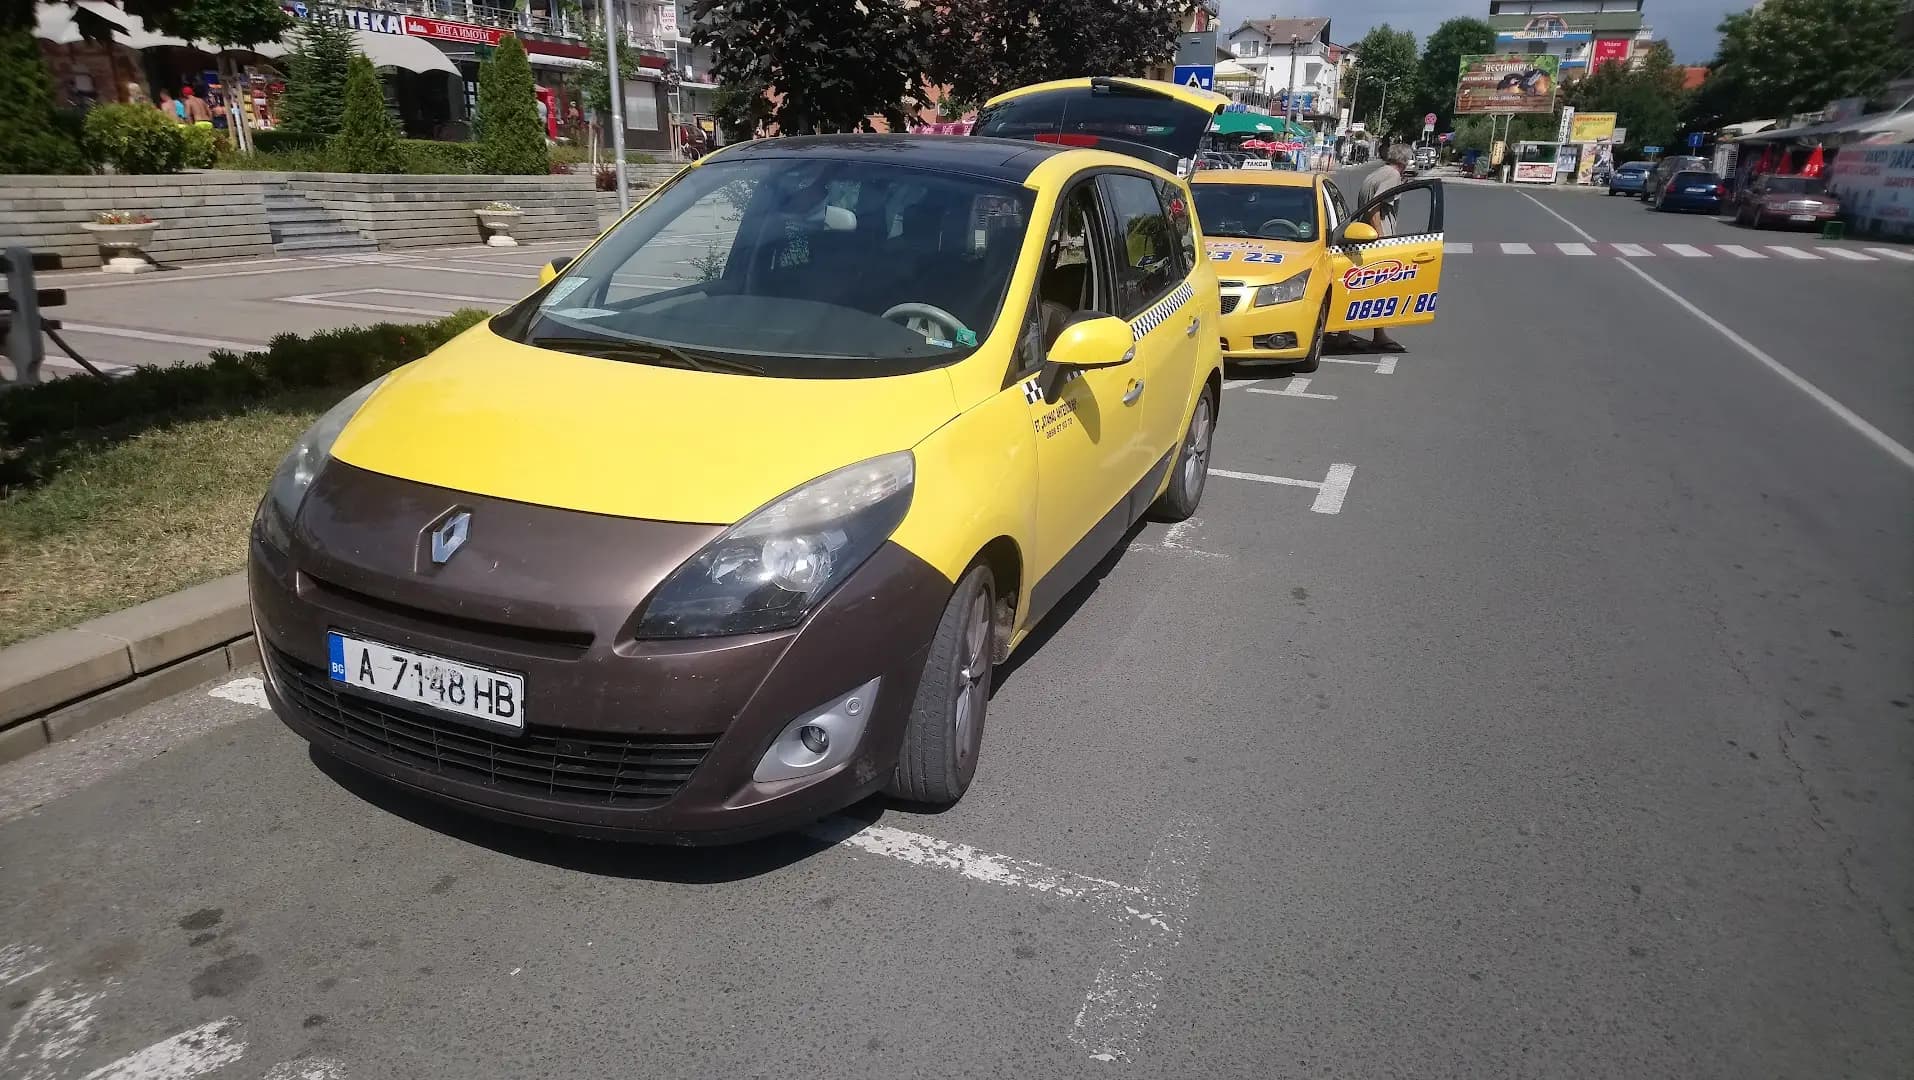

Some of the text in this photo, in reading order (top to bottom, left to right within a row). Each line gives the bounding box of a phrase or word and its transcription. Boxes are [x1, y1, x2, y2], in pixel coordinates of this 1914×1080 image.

[435, 24, 489, 41] МЕГА ИМОТИ
[1242, 251, 1284, 264] 23
[1343, 263, 1418, 288] ОРИОН
[1345, 296, 1399, 321] 0899
[1413, 292, 1438, 313] 80
[332, 662, 345, 675] BG
[359, 648, 515, 718] A 7148 HB
